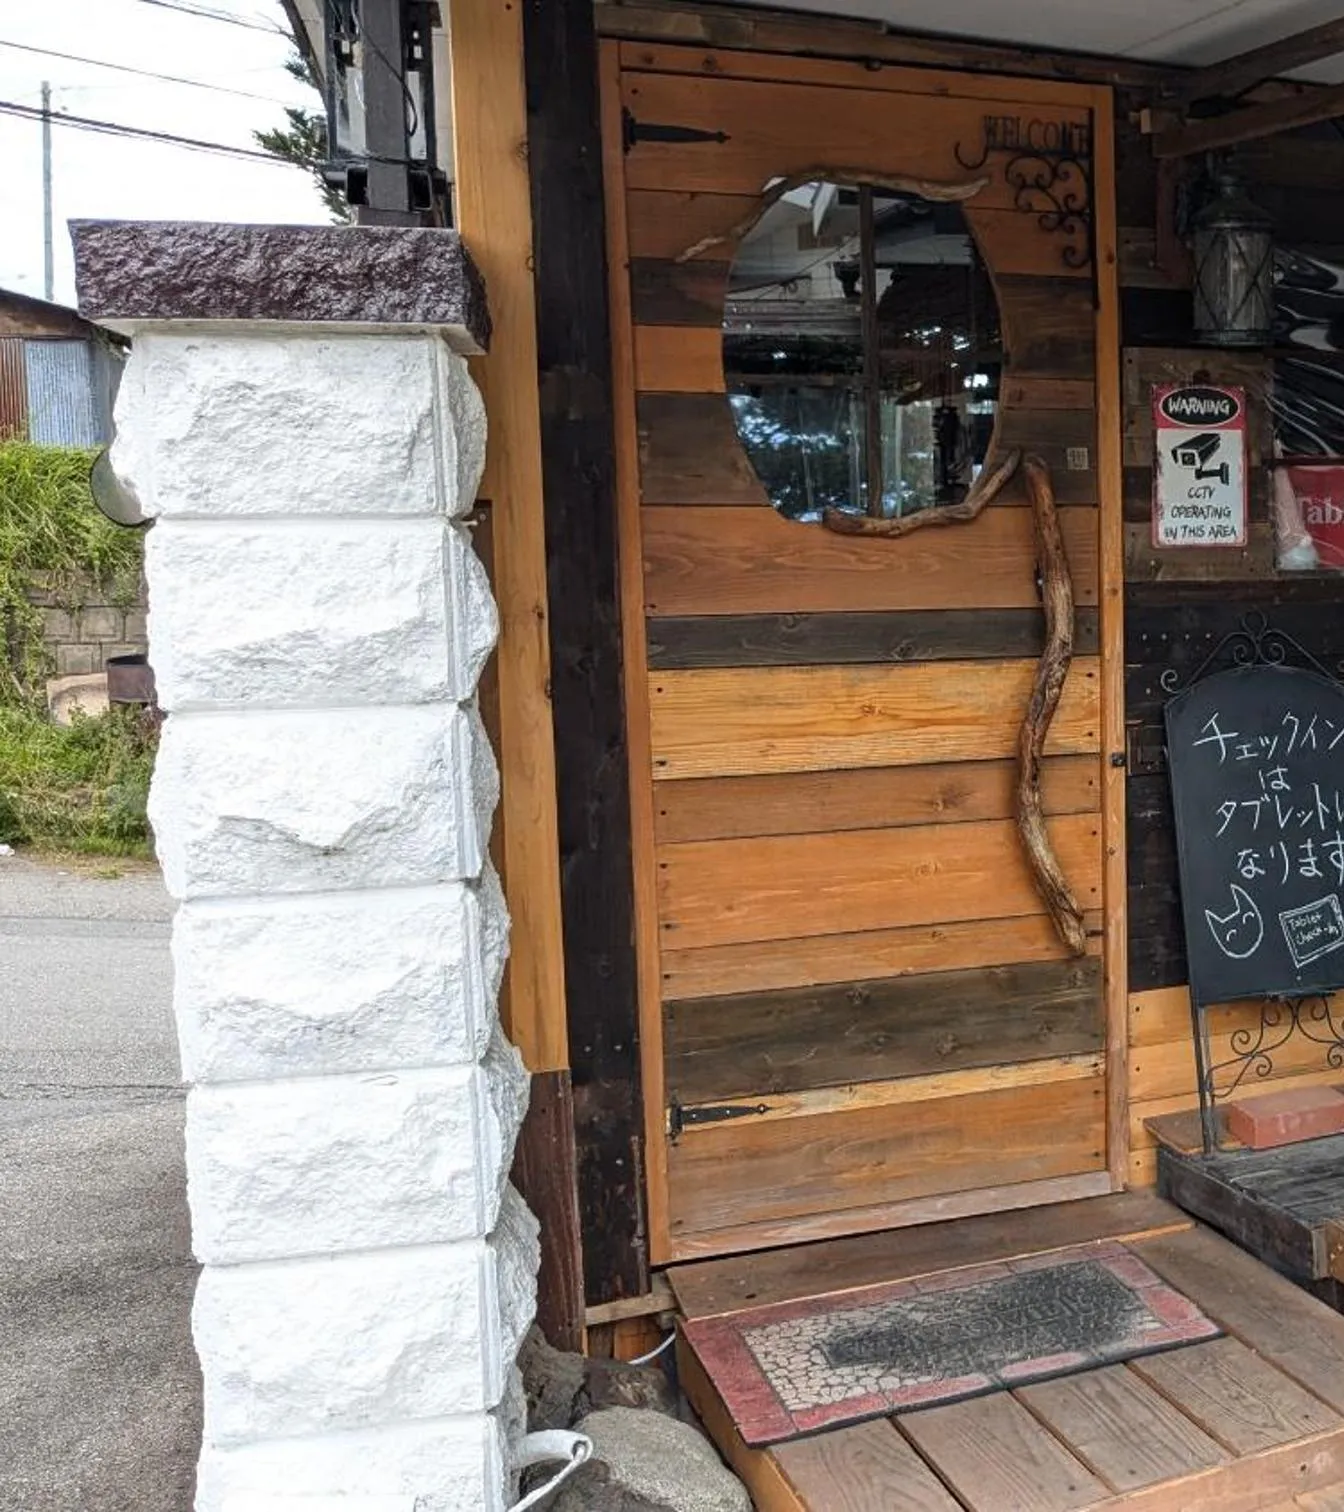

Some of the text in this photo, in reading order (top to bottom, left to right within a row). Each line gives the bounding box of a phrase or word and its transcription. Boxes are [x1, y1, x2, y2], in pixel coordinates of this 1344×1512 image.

[983, 115, 1089, 156] WELCOME
[1167, 396, 1231, 415] WARNING
[1187, 486, 1216, 499] CCTV
[1170, 504, 1231, 520] OPERATING
[1164, 524, 1237, 539] IN THIS AREA
[1258, 766, 1292, 791] は
